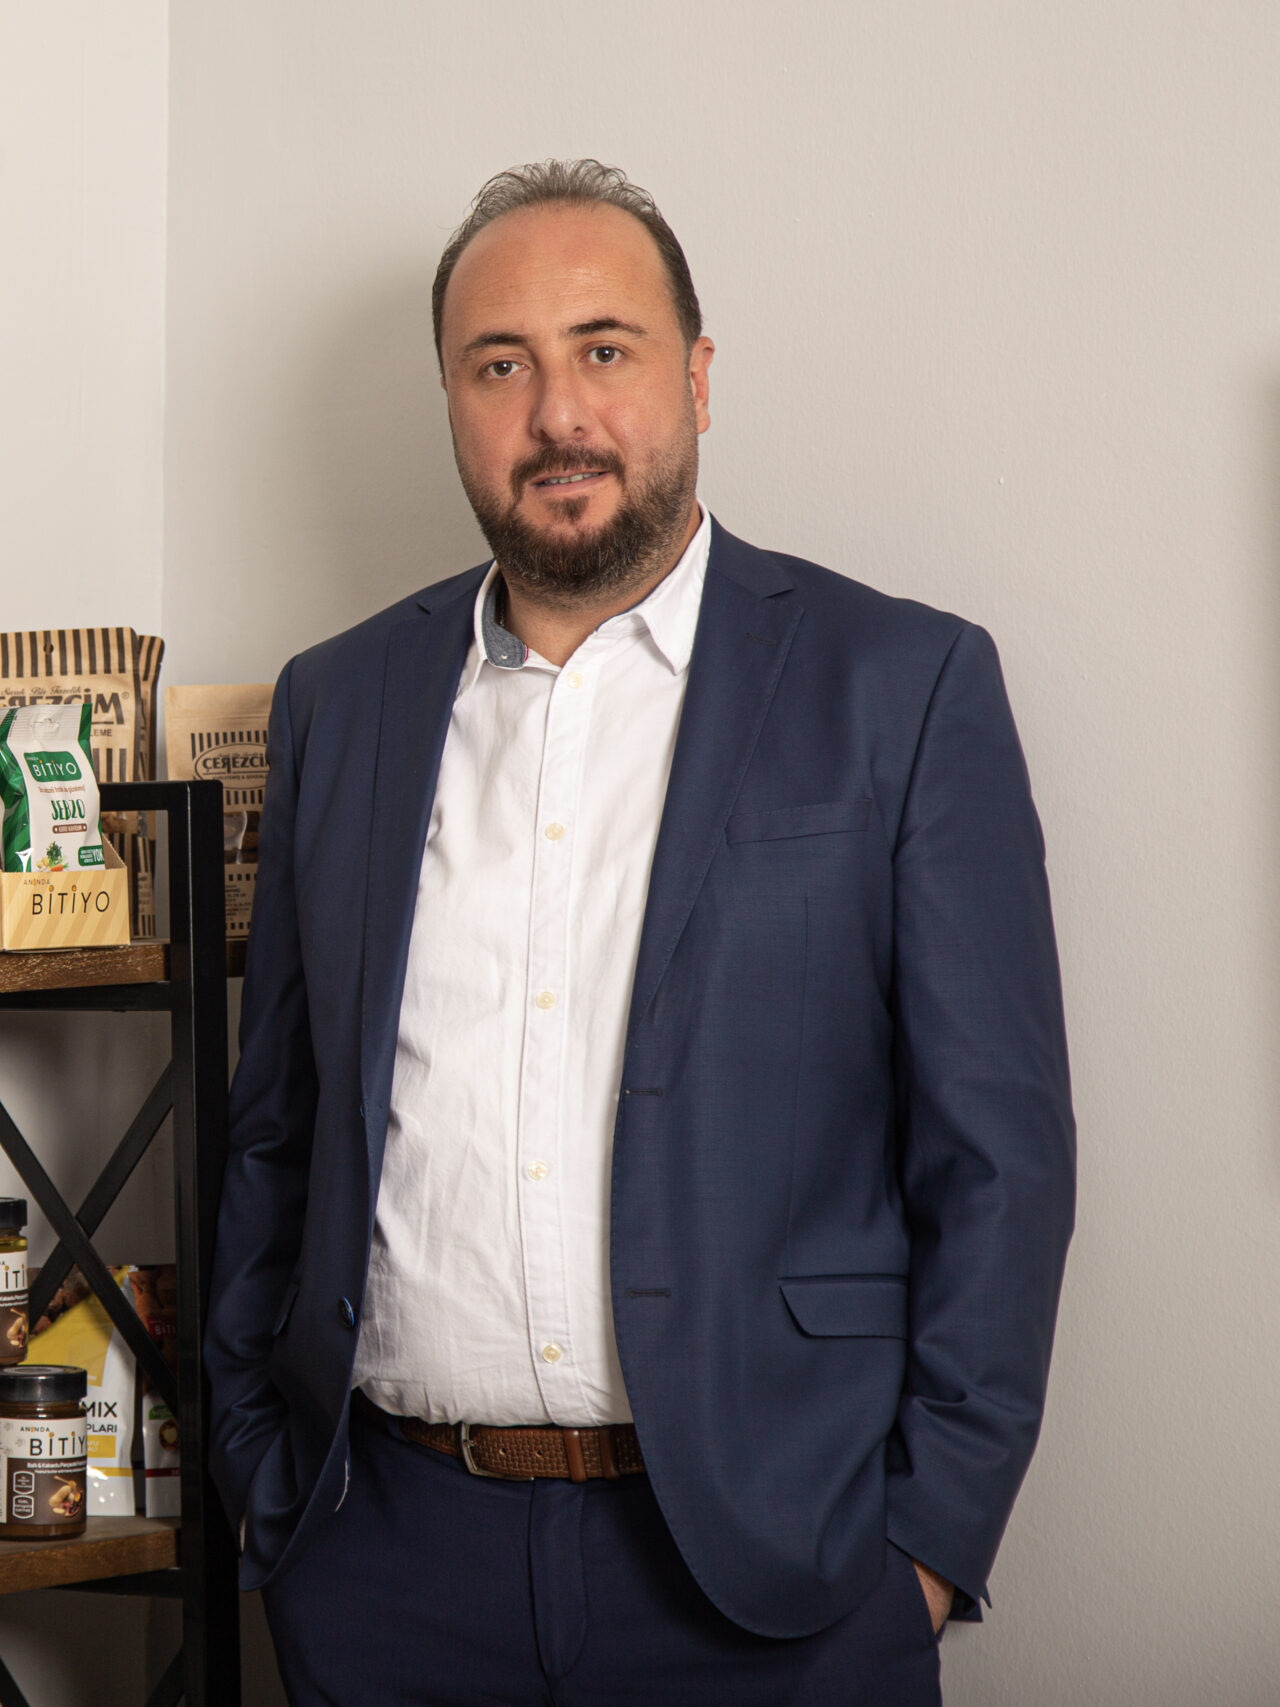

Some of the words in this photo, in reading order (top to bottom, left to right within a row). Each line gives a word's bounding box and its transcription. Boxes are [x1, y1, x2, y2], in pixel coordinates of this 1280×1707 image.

[202, 753, 266, 774] ÇEREZCİ
[51, 799, 86, 820] SEBZO
[87, 1424, 118, 1433] PLARI
[30, 1431, 86, 1456] BİTİY
